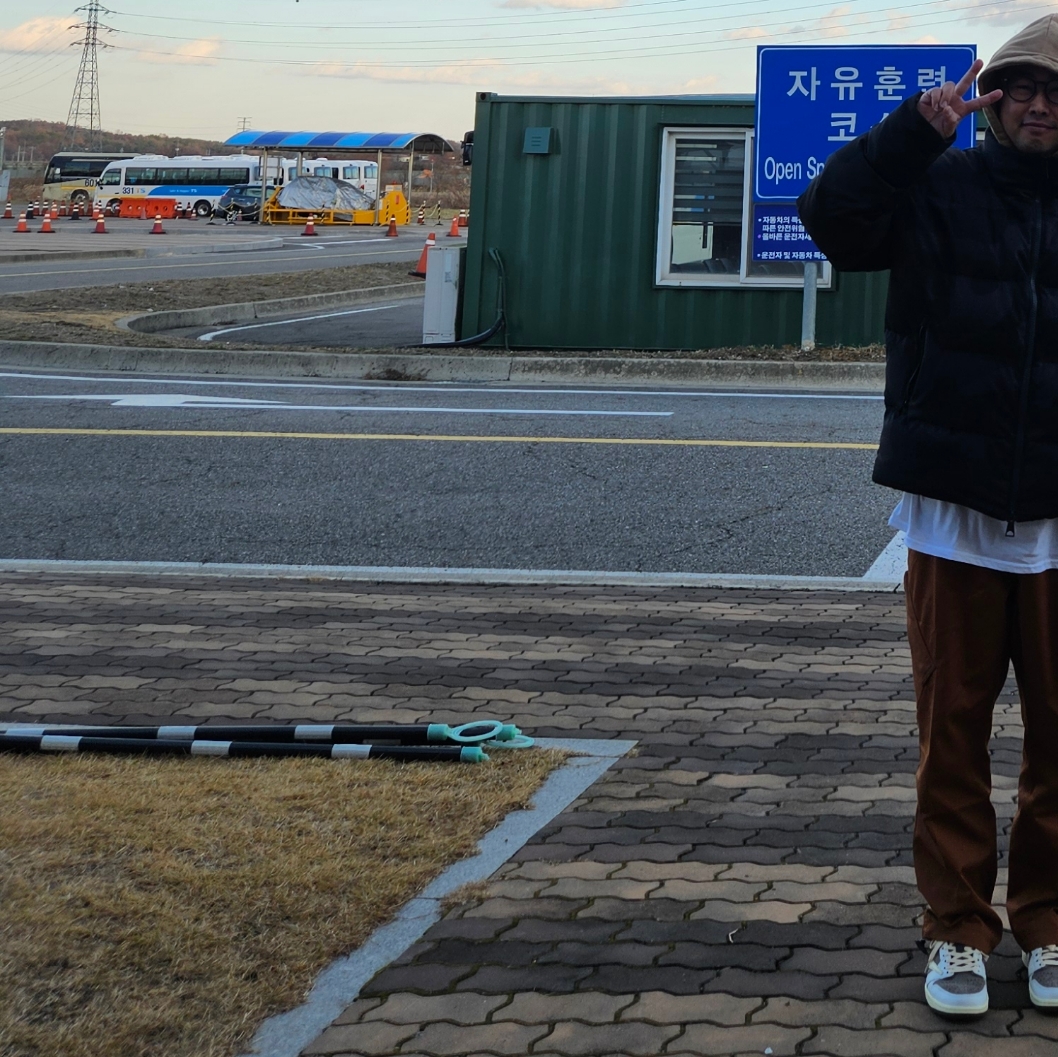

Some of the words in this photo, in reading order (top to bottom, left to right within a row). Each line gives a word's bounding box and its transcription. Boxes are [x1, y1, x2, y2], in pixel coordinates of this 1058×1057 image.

[787, 66, 946, 101] 자유훈련
[764, 156, 802, 185] Open
[762, 216, 790, 224] 자동차의
[761, 251, 782, 260] 운전자
[791, 251, 812, 260] 자동차
